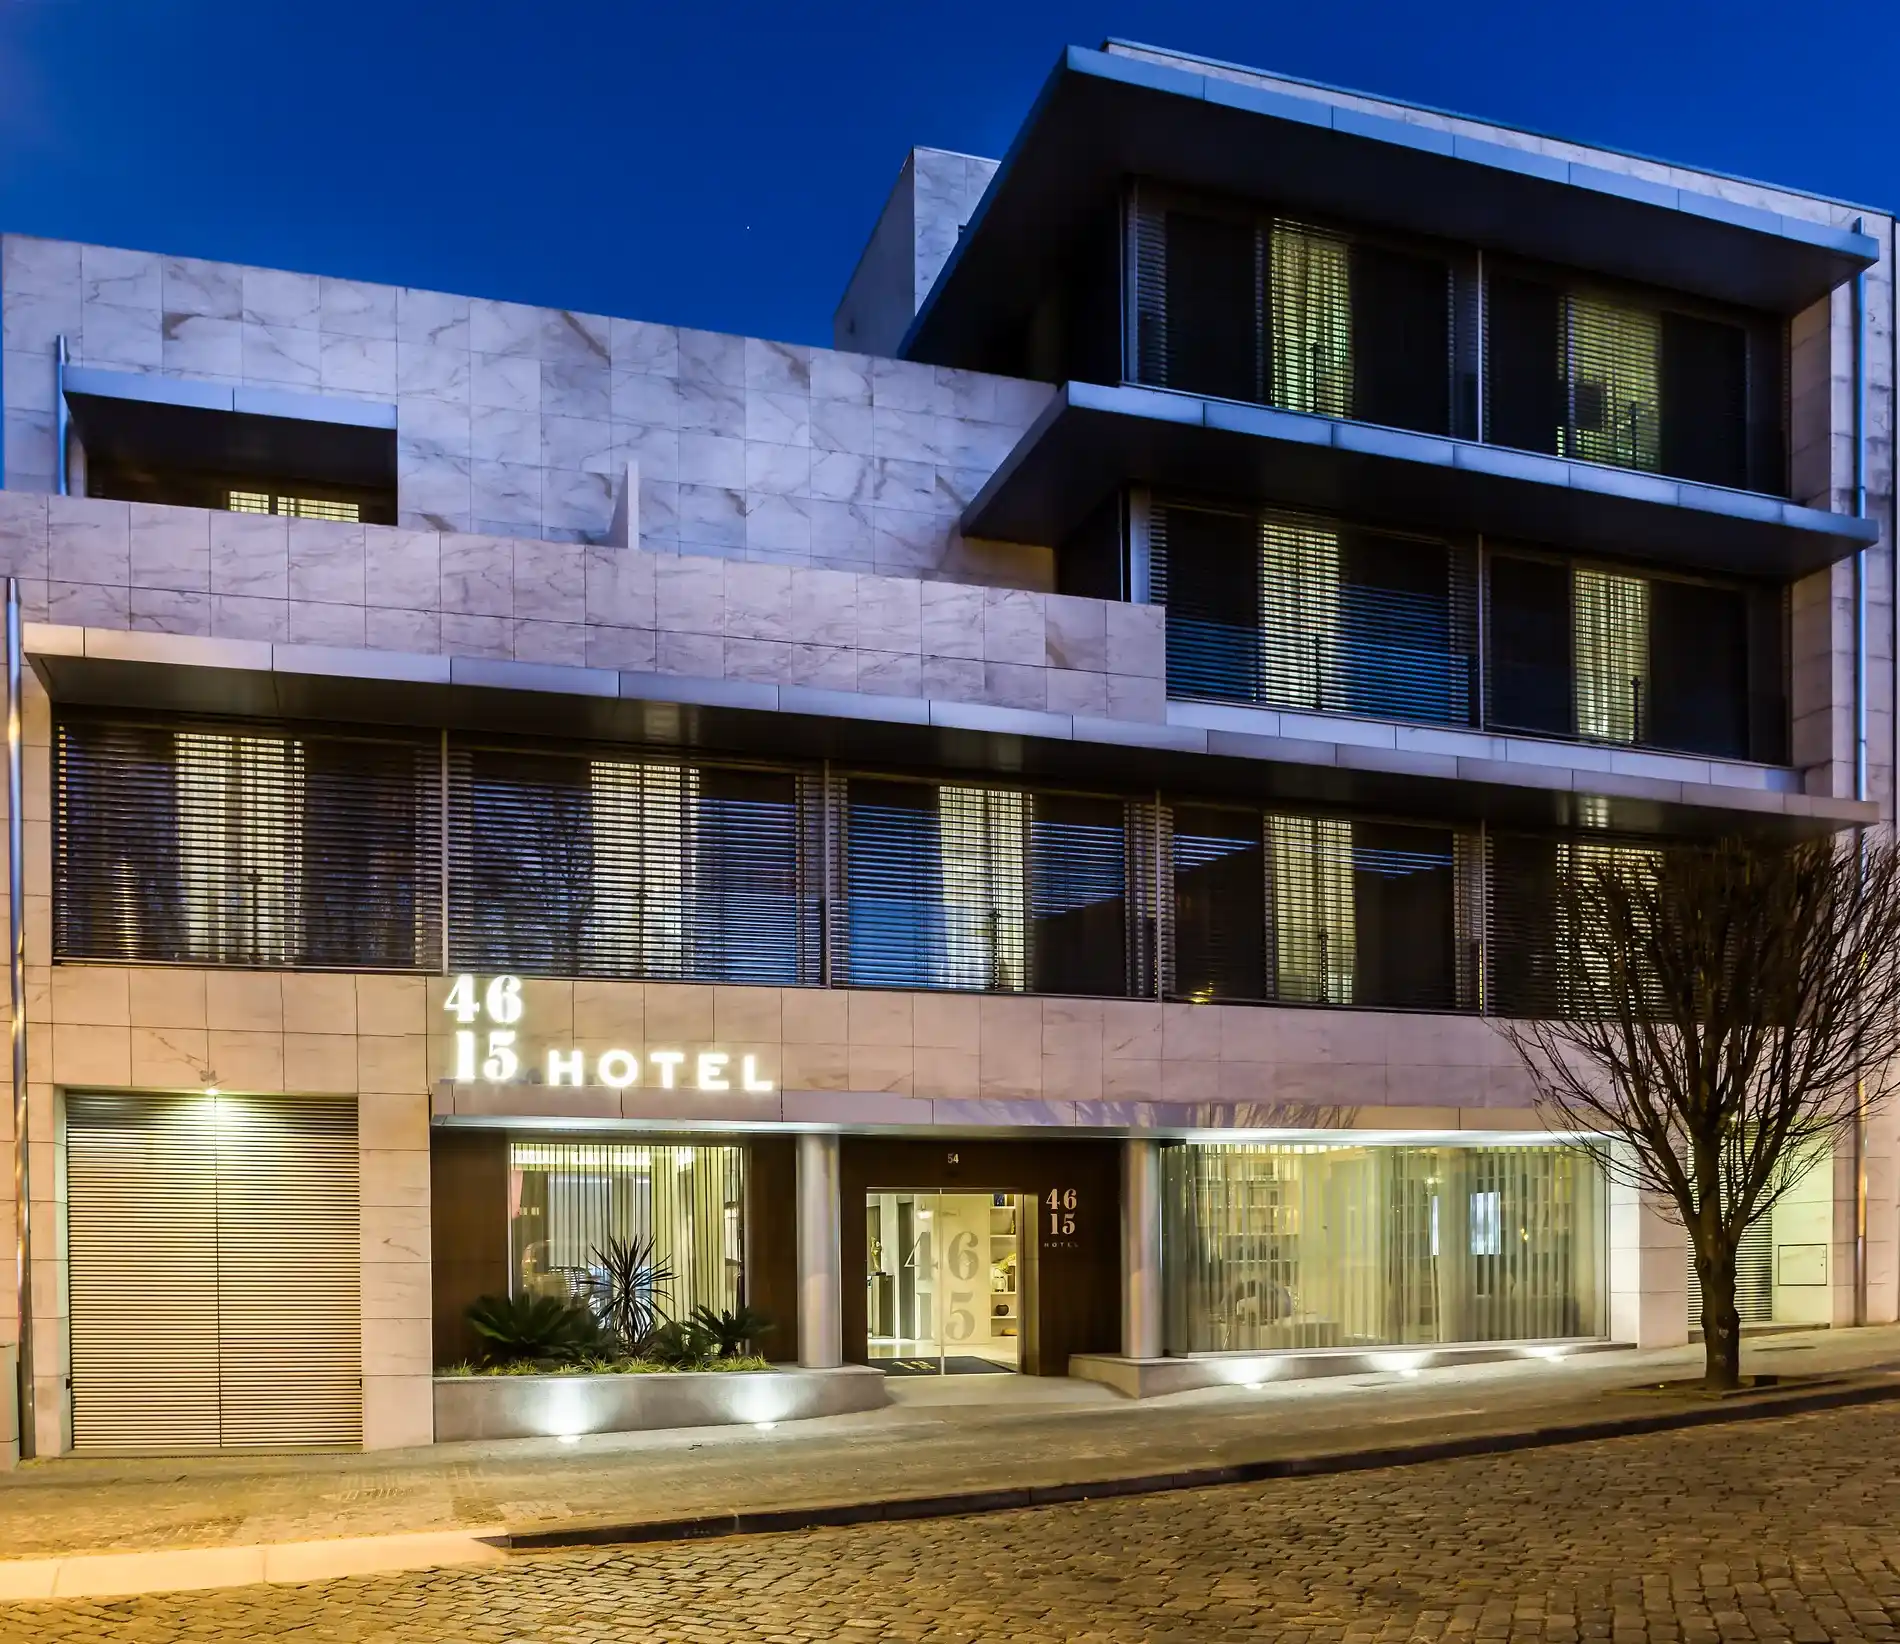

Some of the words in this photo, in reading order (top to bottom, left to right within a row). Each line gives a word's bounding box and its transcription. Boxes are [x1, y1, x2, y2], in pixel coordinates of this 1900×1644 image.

[443, 974, 523, 1024] 46
[454, 1030, 519, 1083] 15
[548, 1049, 774, 1091] HOTEL
[947, 1153, 960, 1164] 54
[1045, 1188, 1077, 1210] 46
[1050, 1213, 1076, 1235] 15
[904, 1231, 980, 1281] 46
[915, 1291, 976, 1341] 15
